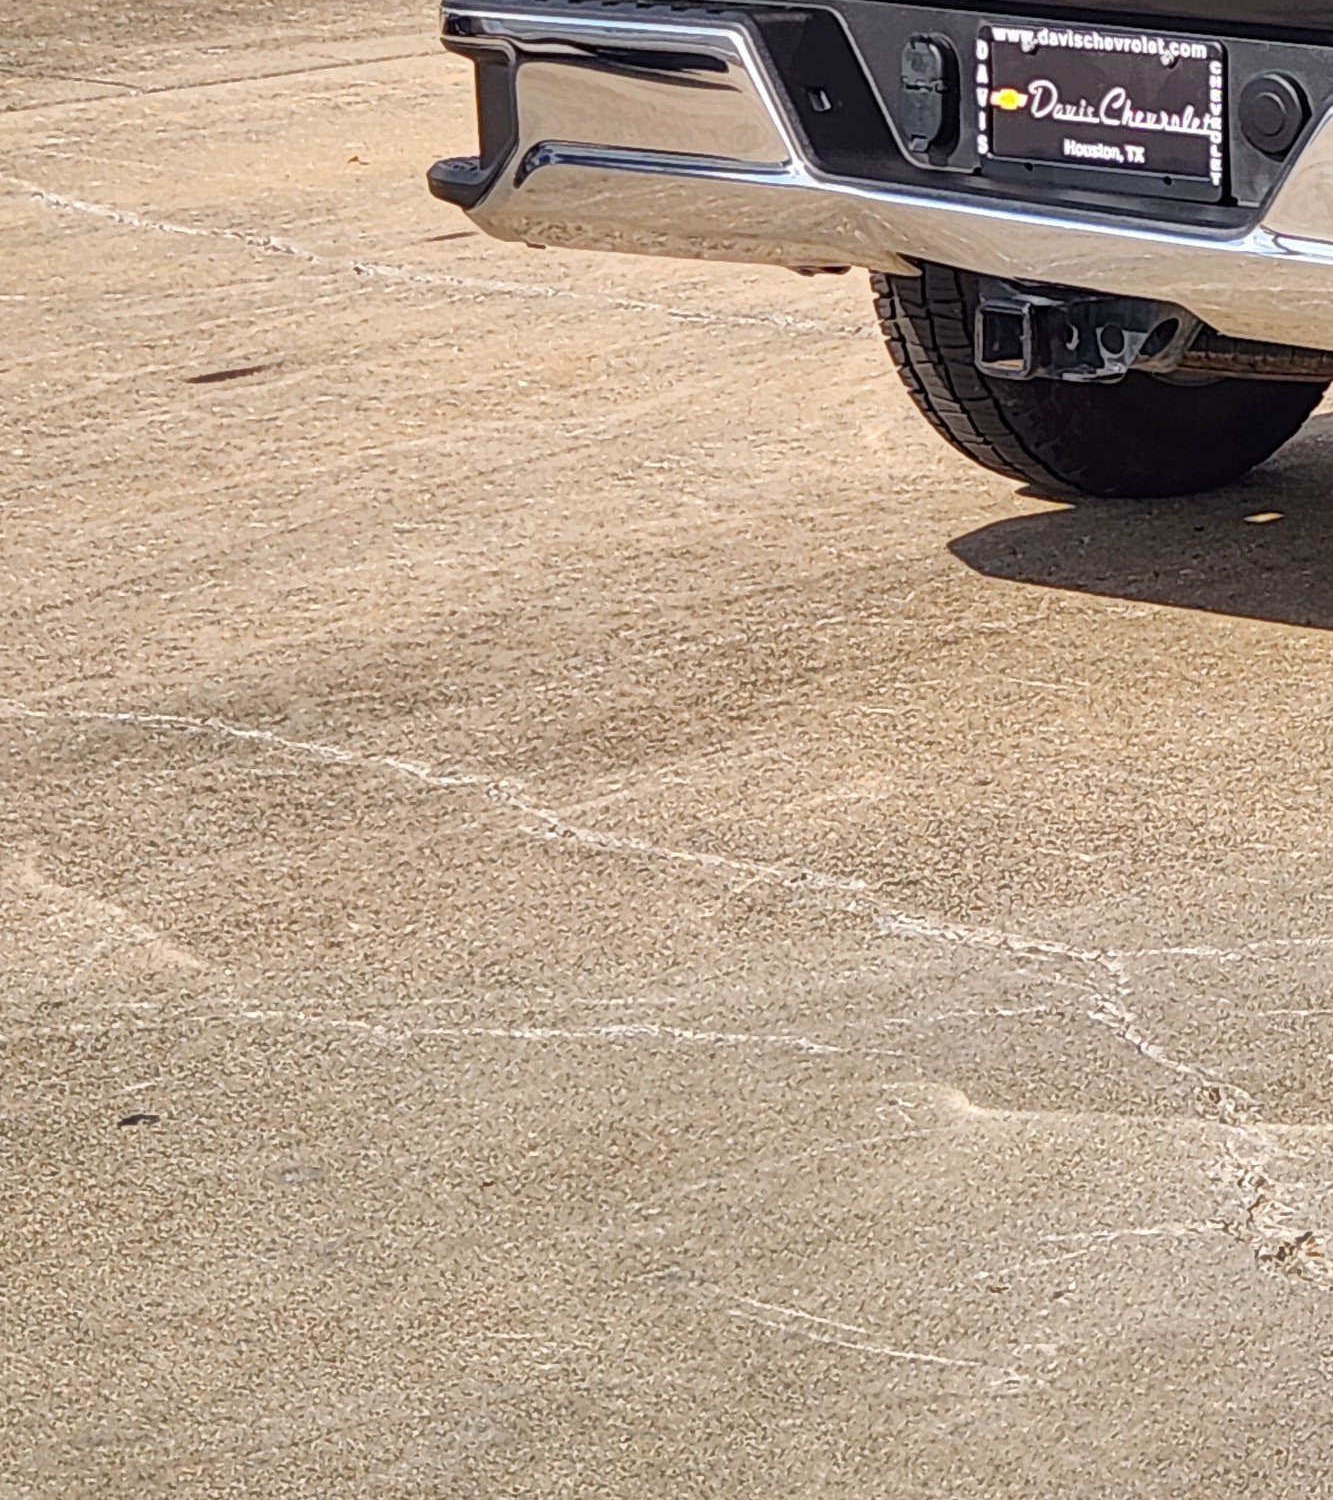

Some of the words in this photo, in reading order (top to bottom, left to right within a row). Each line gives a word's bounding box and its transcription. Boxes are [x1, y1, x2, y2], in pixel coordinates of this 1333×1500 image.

[992, 27, 1207, 59] www.davischevrolet.com
[976, 40, 989, 155] DAVIS
[1028, 79, 1099, 124] Davis
[1100, 87, 1211, 137] Chevrolet
[1209, 61, 1222, 186] CHEVROLET
[1125, 145, 1145, 163] TX
